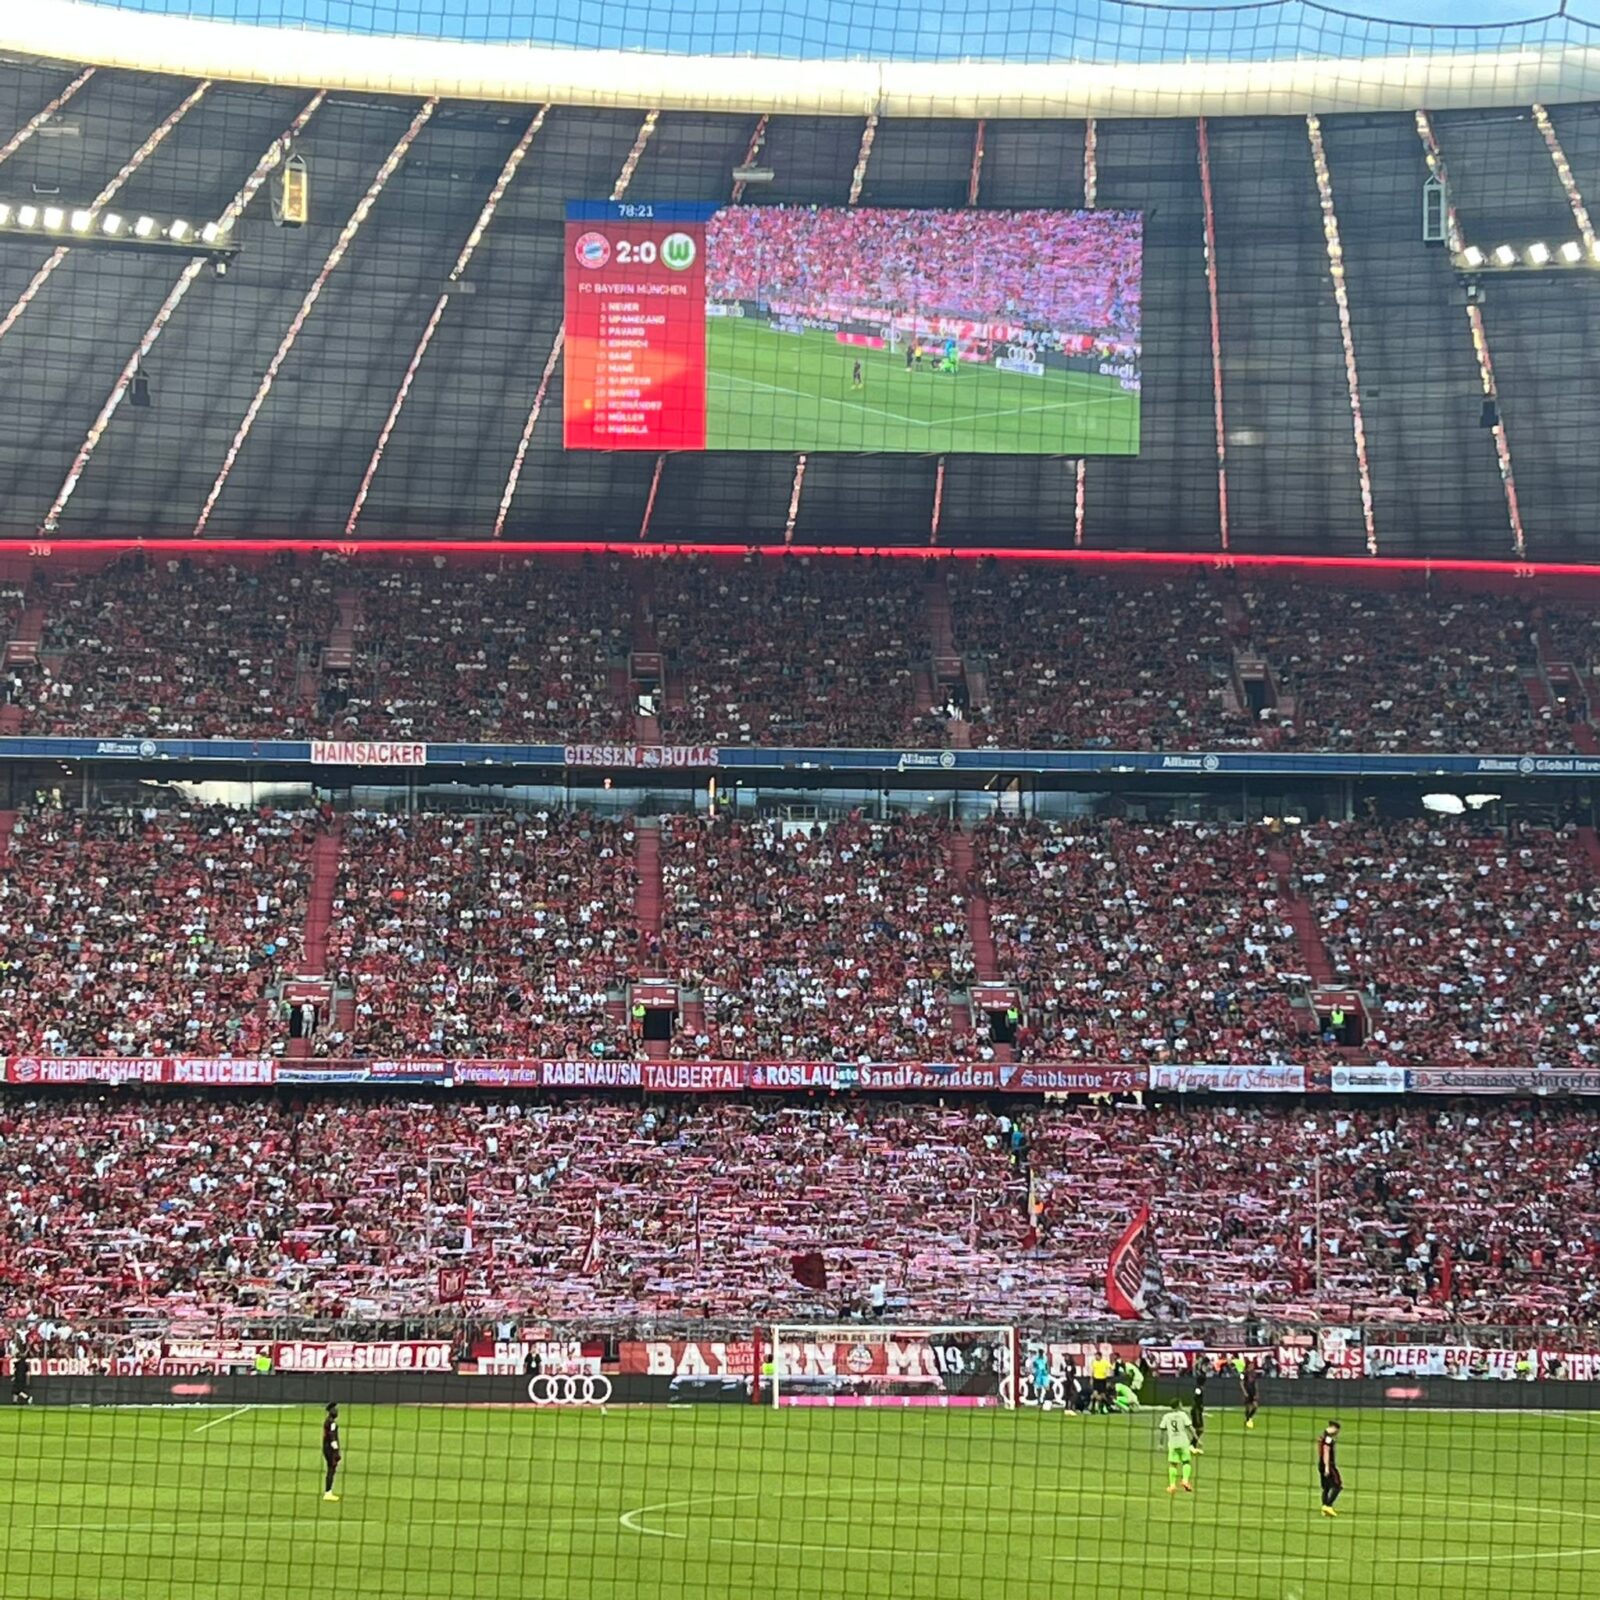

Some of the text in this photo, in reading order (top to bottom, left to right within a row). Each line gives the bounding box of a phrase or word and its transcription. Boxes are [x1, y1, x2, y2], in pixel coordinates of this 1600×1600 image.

[618, 204, 654, 217] 78:21
[616, 240, 657, 264] 2:0
[578, 283, 592, 293] FC
[594, 283, 634, 294] BAYERN
[314, 743, 423, 763] HAINSACKER
[564, 746, 719, 766] GIESSEN BULLS
[39, 1060, 164, 1081] FRIEDRICHSHAFEN
[173, 1060, 273, 1082] MEUCHEN
[645, 1066, 744, 1088] TAUBERTAL
[416, 1344, 452, 1368] rot
[1171, 1420, 1180, 1433] 9
